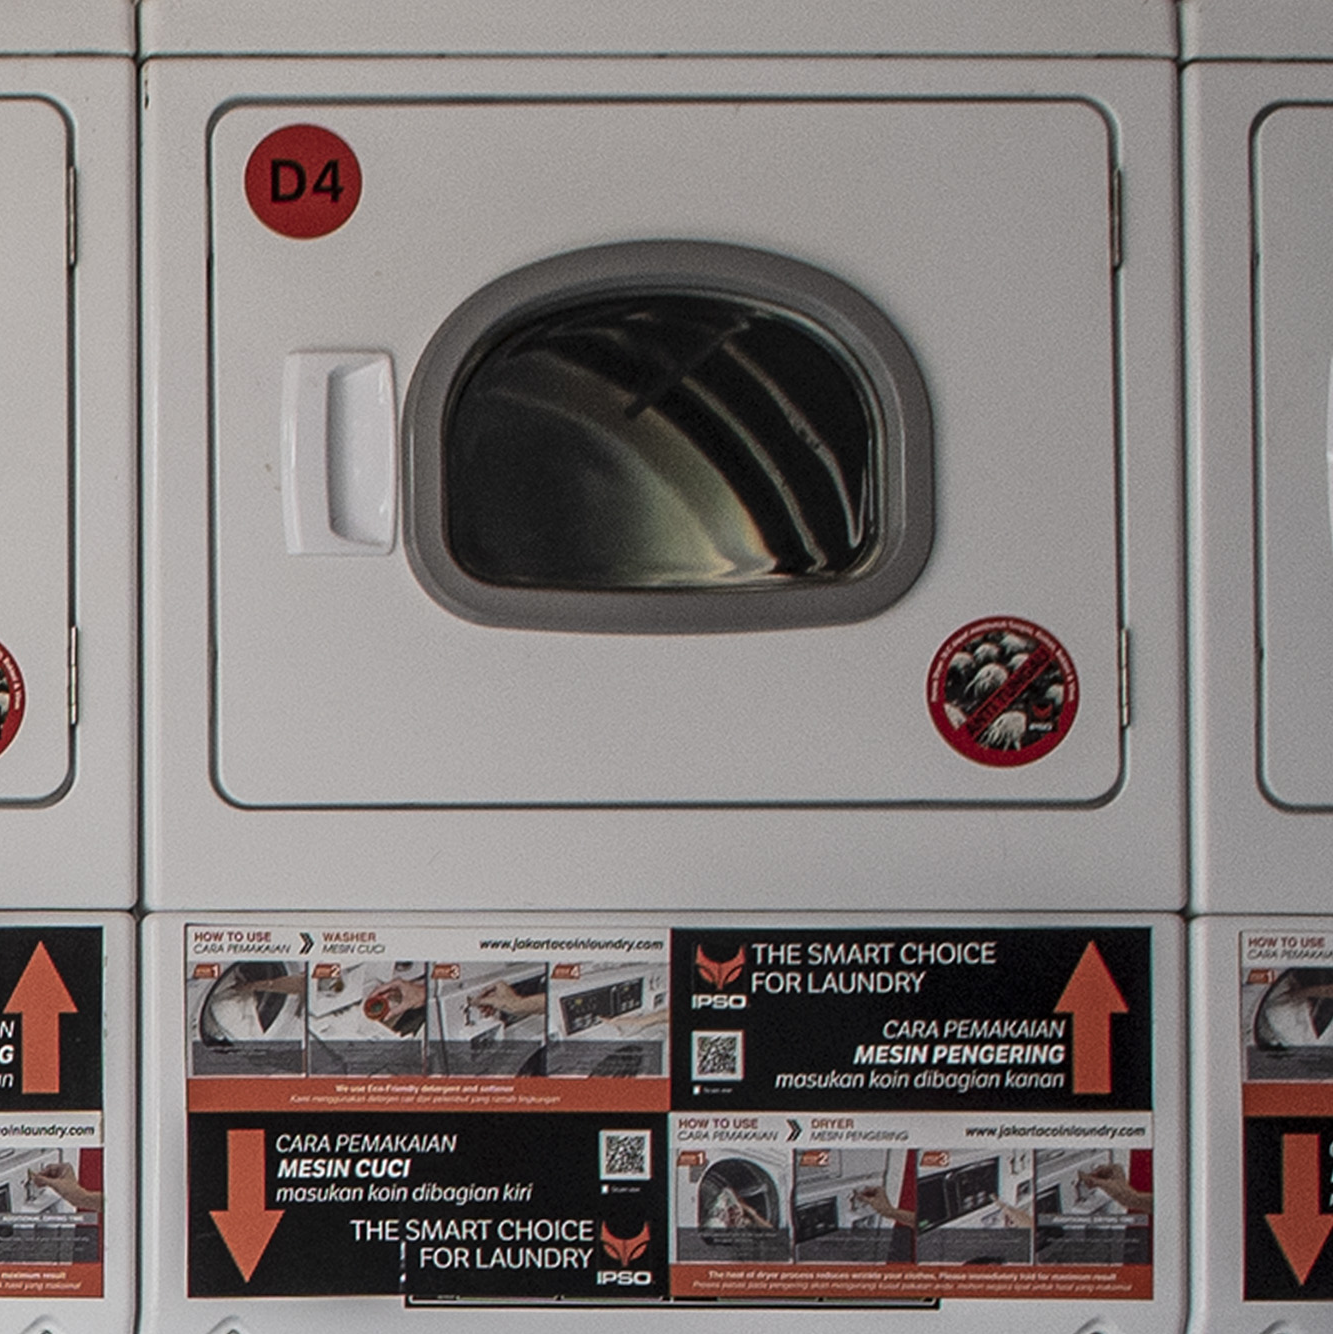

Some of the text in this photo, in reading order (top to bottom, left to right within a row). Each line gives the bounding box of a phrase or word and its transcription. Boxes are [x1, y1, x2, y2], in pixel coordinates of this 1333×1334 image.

[269, 158, 345, 205] D4
[194, 930, 272, 945] HOW TO USE
[322, 931, 377, 945] WASHER
[751, 941, 996, 966] THE SMART CHOICE
[751, 971, 926, 994] FOR LAUNDRY
[691, 994, 747, 1010] IPSO
[882, 1019, 1066, 1040] CARA PEMAKAIAN
[853, 1044, 1065, 1065] MESIN PENGERING
[774, 1069, 1065, 1094] masukan koin dibagian kanan
[275, 1133, 458, 1153] CARA PEMAKAIAN
[277, 1158, 411, 1179] MESIN CUCI
[275, 1182, 533, 1206] masukan koin dibagian kiri
[349, 1218, 594, 1242] THE SMART CHOICE
[420, 1246, 594, 1269] FOR LAUNDRY
[596, 1270, 652, 1286] IPSO
